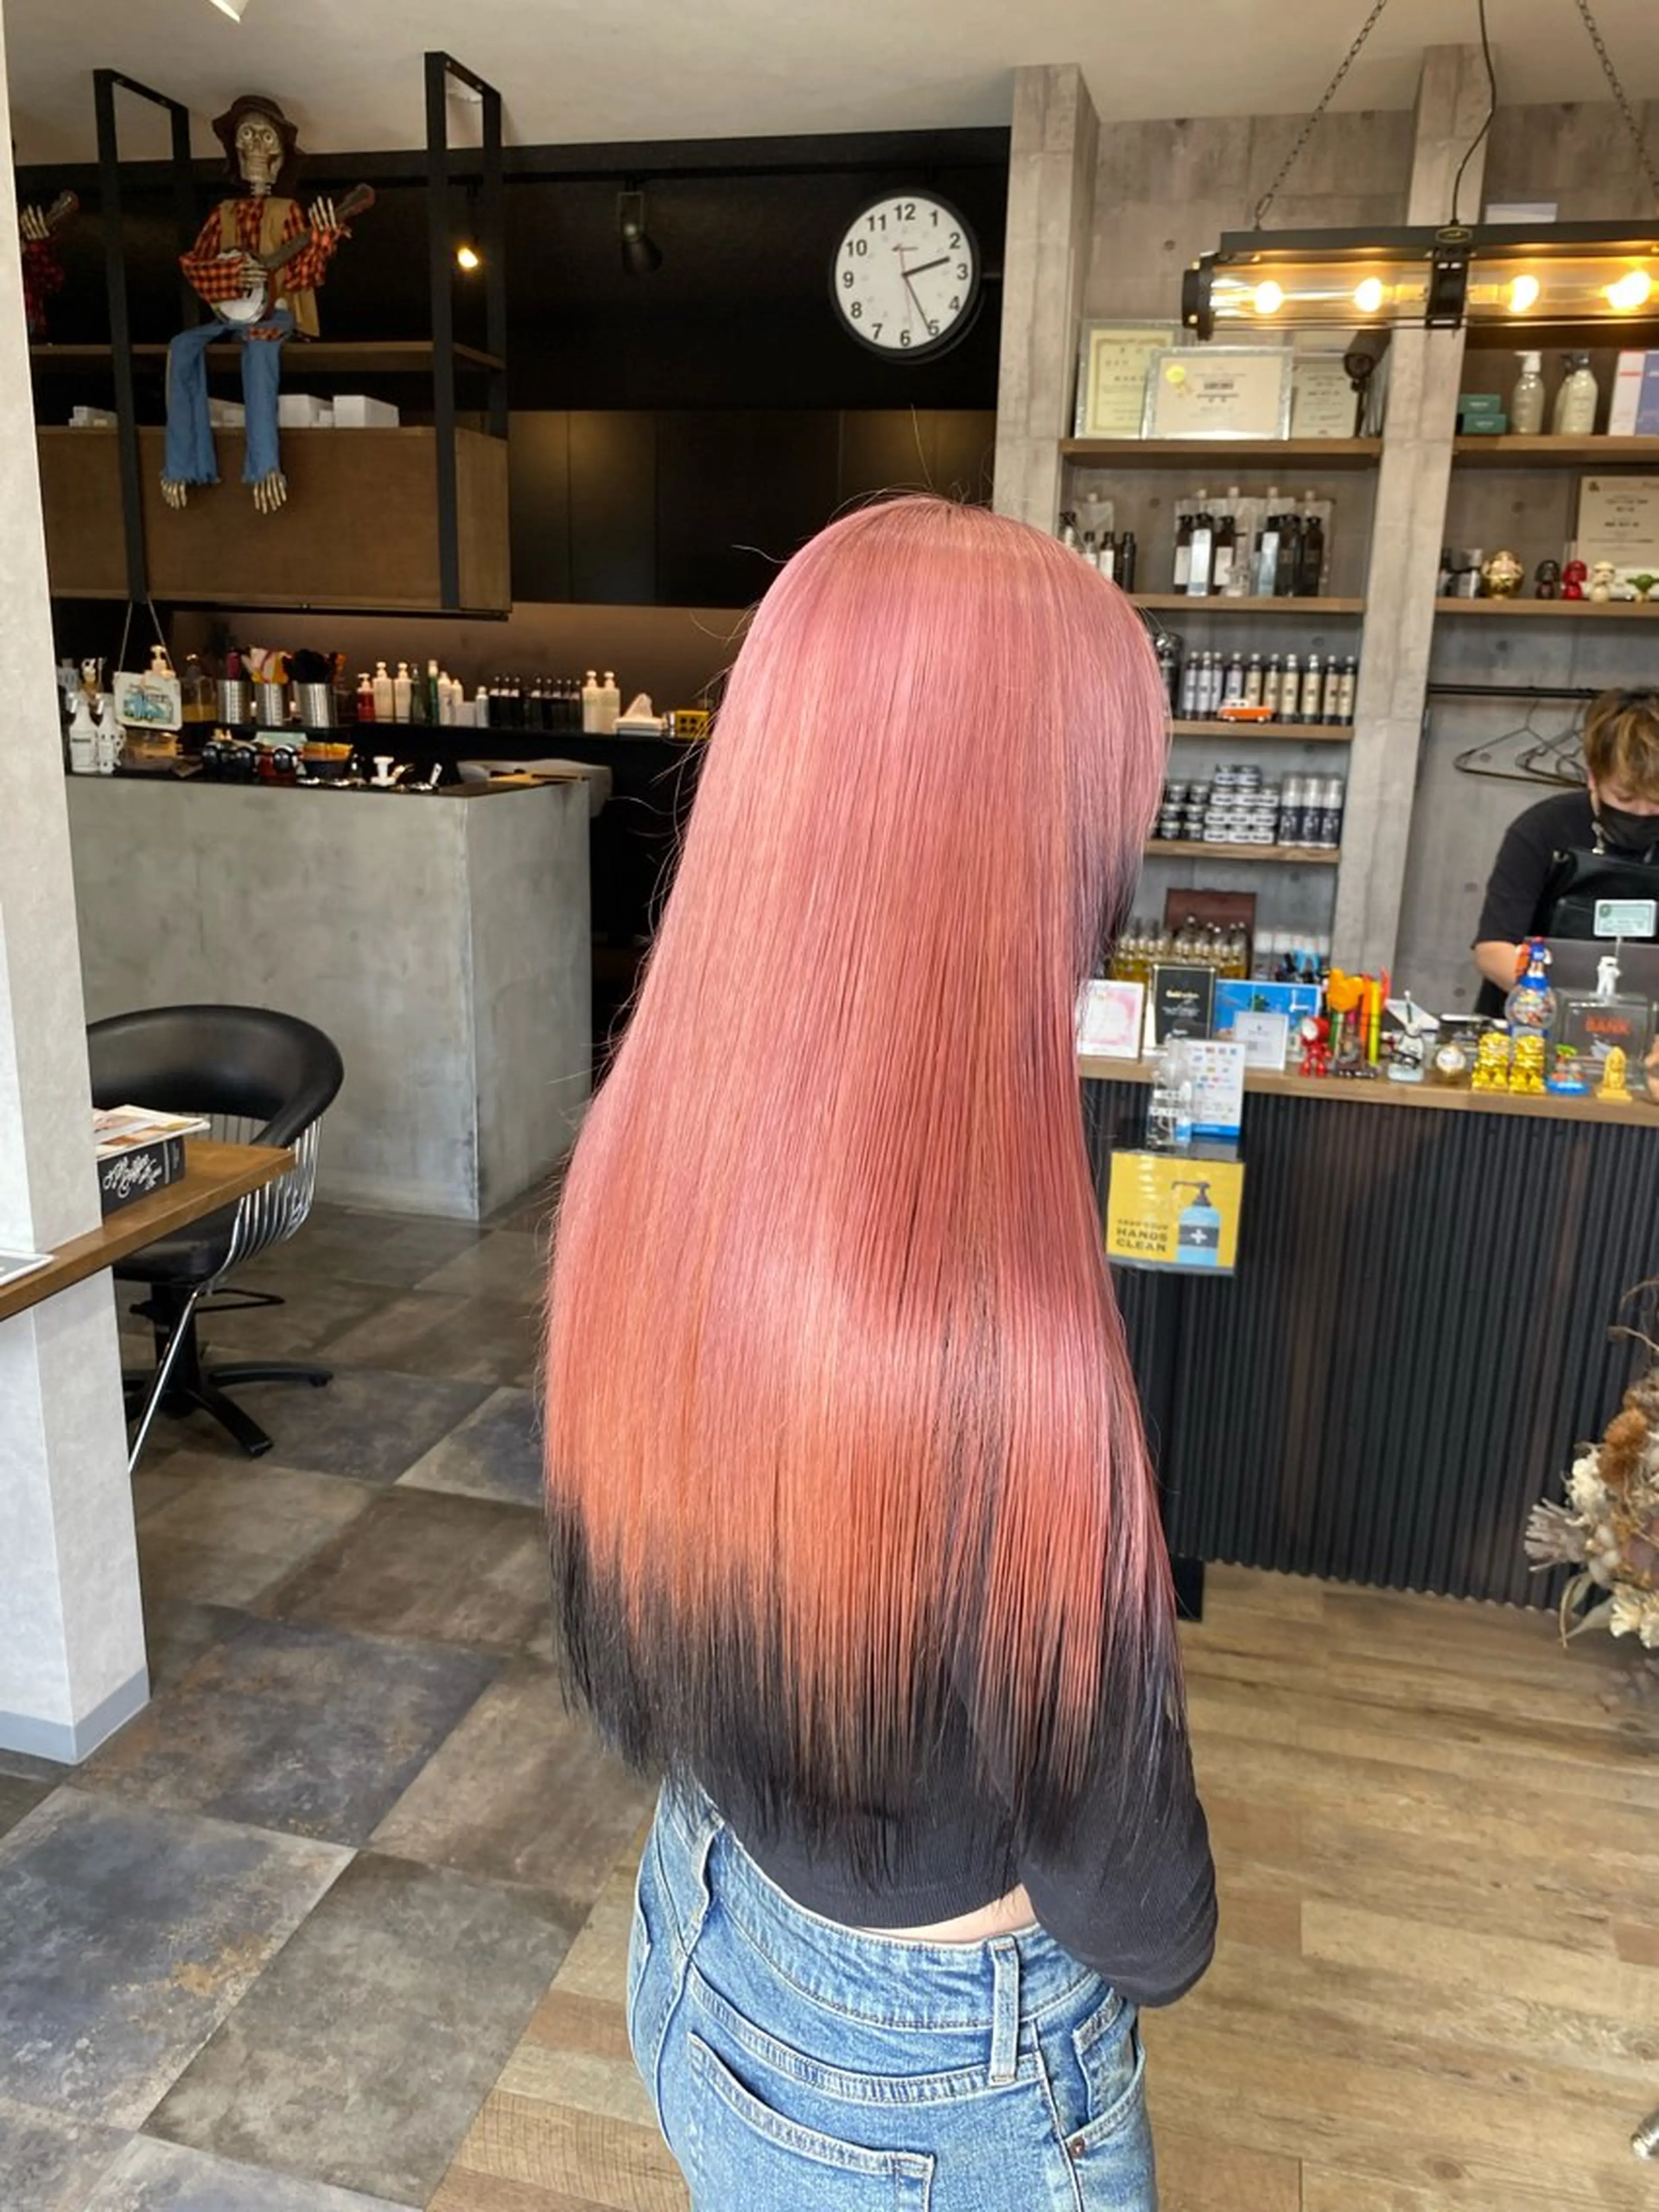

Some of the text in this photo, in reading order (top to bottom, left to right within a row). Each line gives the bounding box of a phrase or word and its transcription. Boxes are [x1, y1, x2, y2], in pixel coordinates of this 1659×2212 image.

[893, 203, 916, 221] 12
[930, 210, 938, 227] 1
[866, 214, 887, 232] 11
[846, 239, 868, 257] 10
[950, 232, 961, 249] 2
[842, 271, 854, 289] 9
[956, 263, 969, 281] 3
[851, 302, 862, 319] 8
[949, 296, 960, 312] 4
[871, 323, 884, 340] 7
[928, 319, 940, 336] 5
[900, 330, 911, 347] 6
[1116, 1227, 1168, 1242] HANDS
[1116, 1237, 1166, 1252] CLEAN
